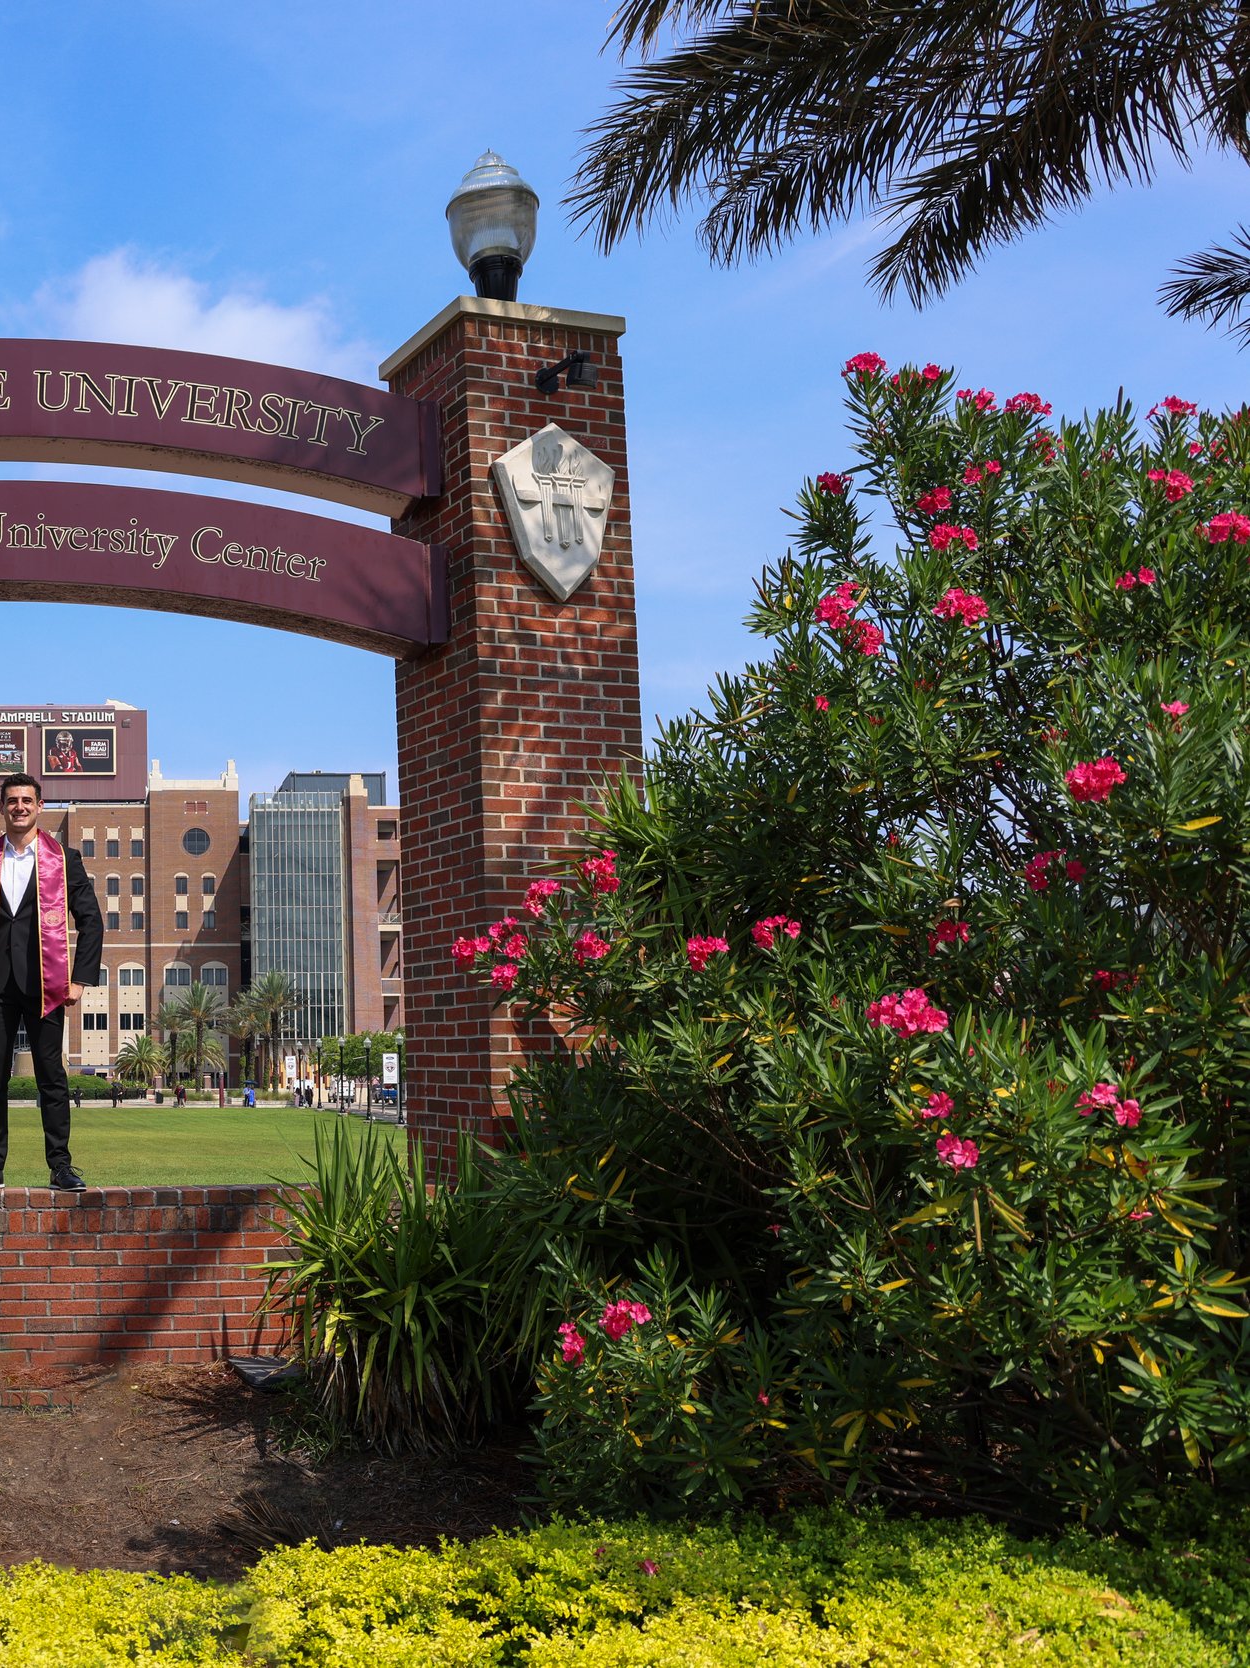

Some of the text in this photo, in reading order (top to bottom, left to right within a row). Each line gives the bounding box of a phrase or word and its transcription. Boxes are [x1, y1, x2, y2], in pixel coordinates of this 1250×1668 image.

[33, 369, 384, 456] UNIVERSITY
[190, 526, 327, 582] Center
[61, 712, 115, 722] STADIUM
